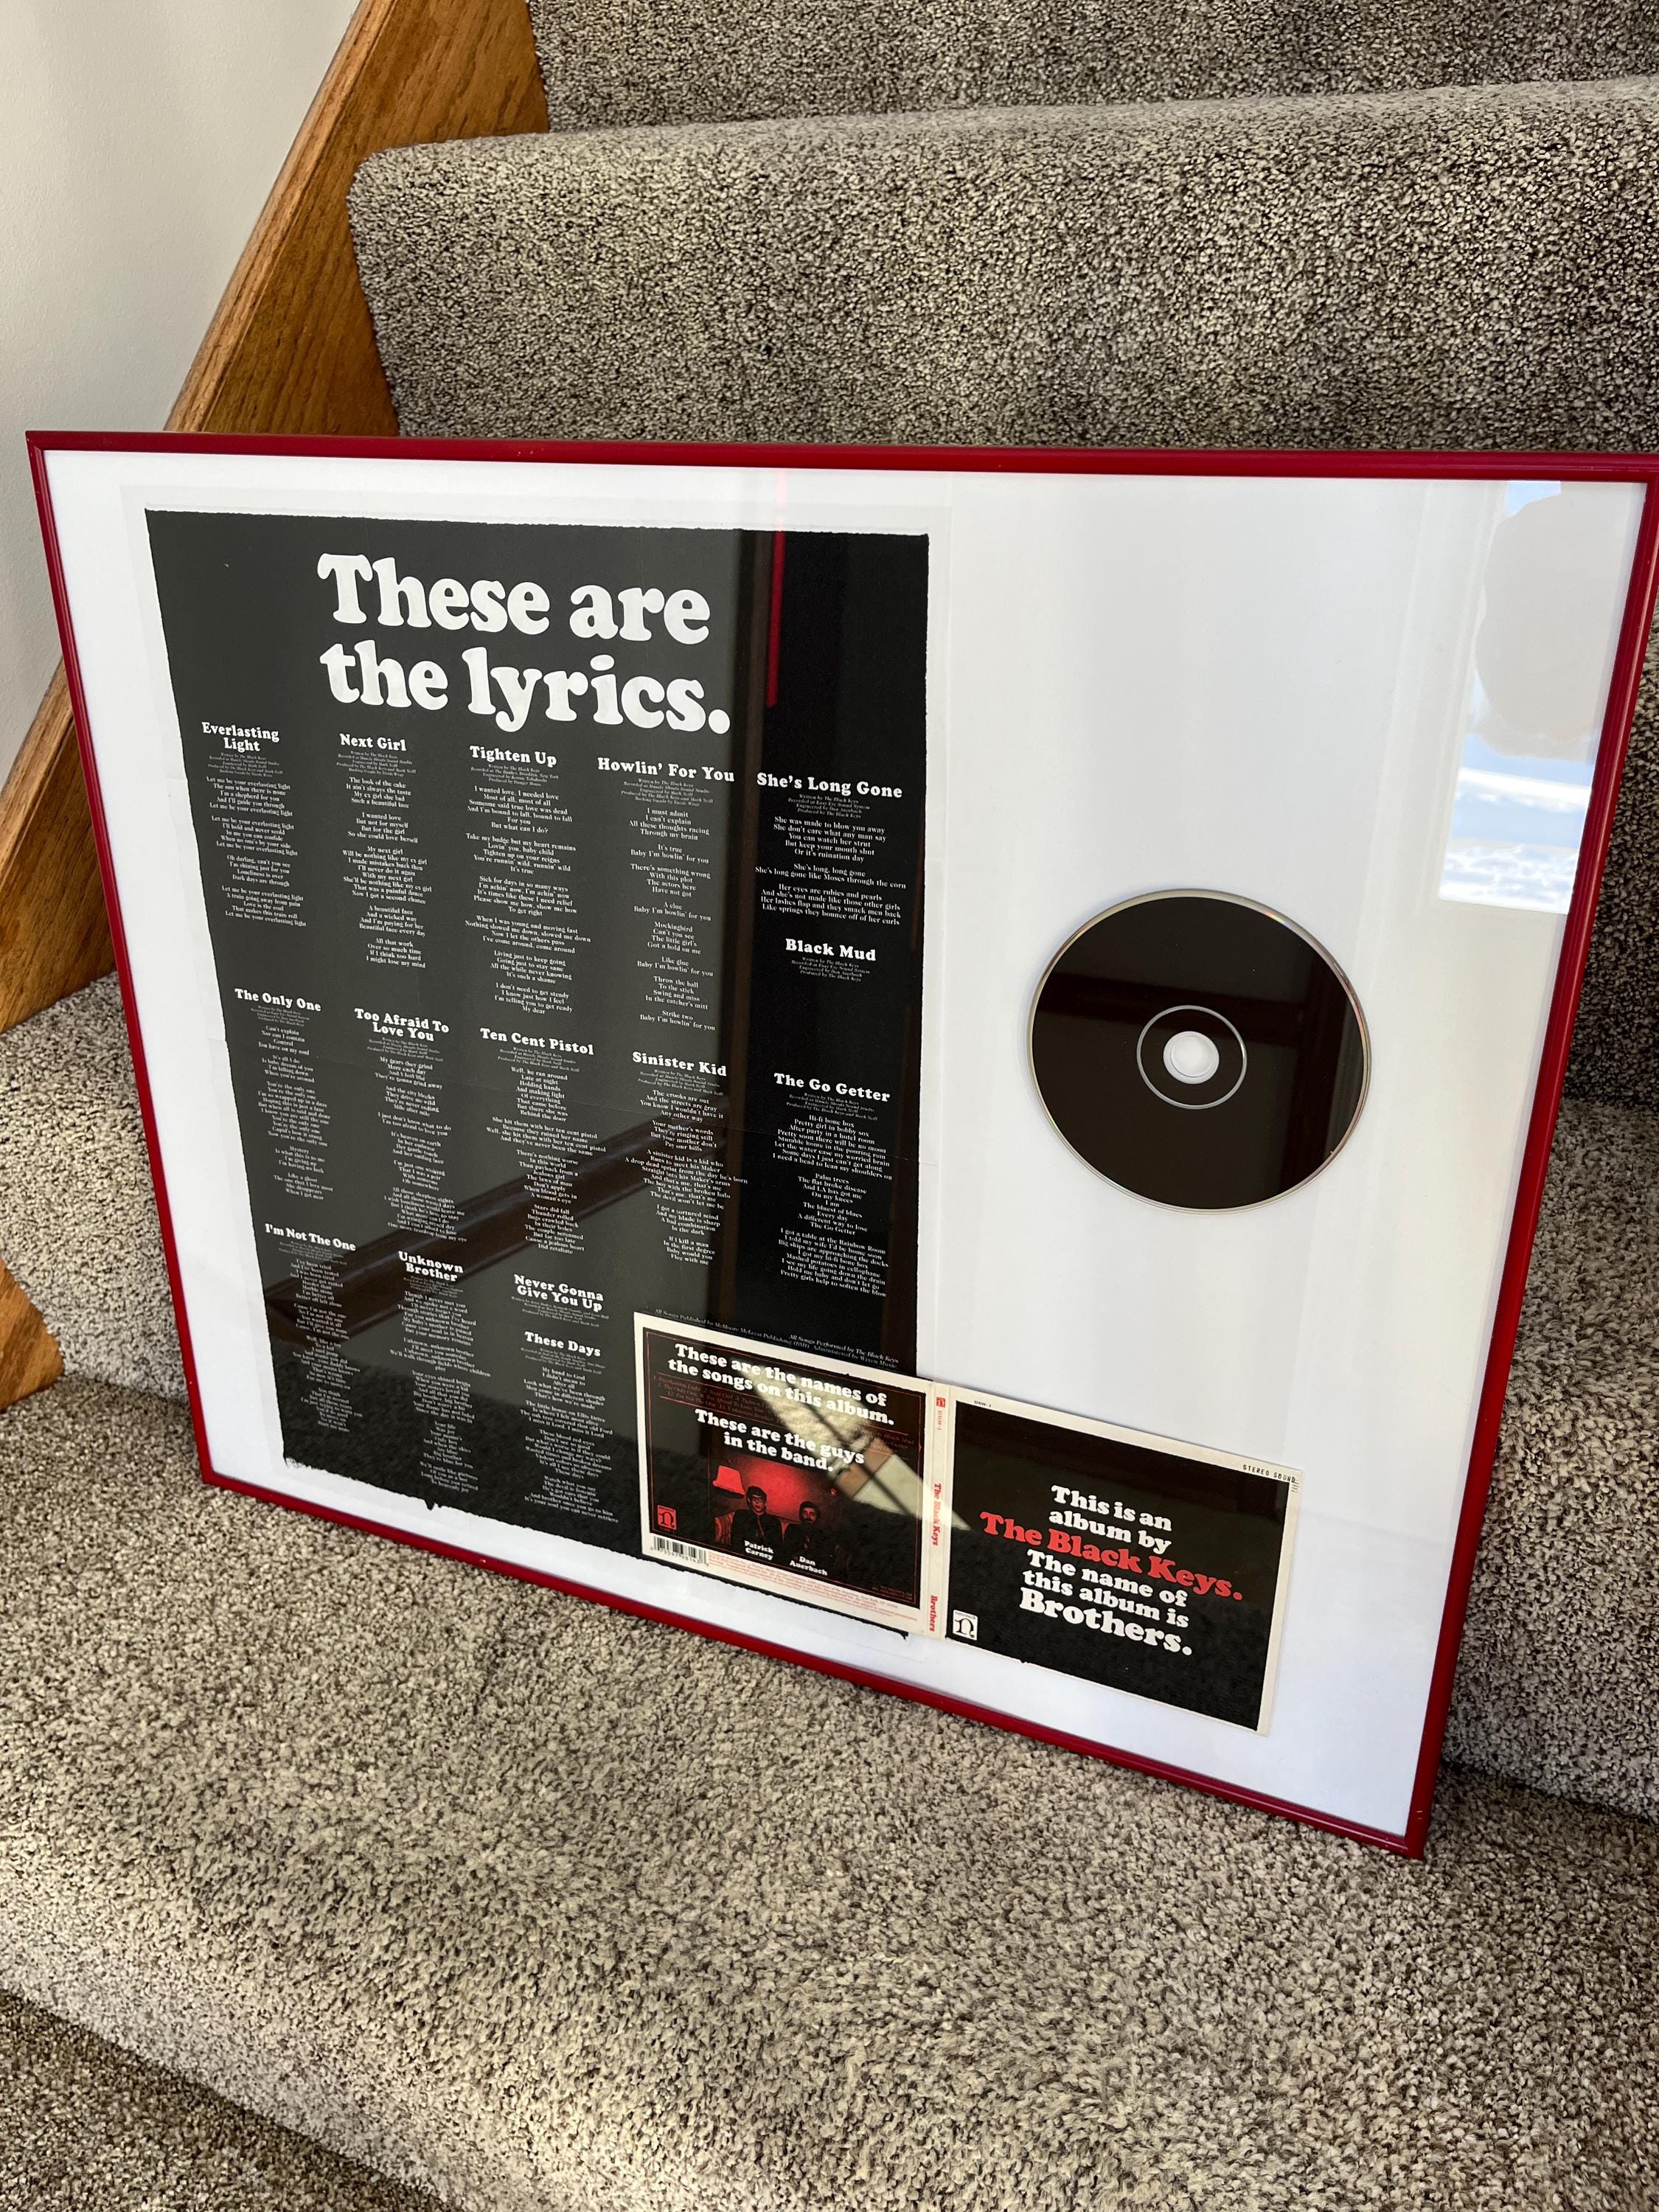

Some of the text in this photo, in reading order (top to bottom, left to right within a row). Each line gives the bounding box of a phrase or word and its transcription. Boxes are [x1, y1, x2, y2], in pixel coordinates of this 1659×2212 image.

[318, 554, 710, 644] These are
[320, 640, 730, 734] the lyrics.
[202, 721, 279, 742] Everlasting
[341, 733, 406, 751] Next Girl
[224, 737, 260, 752] Light
[469, 745, 556, 767] Tighten Up
[598, 757, 734, 781] Howlin' For You
[546, 792, 558, 800] love
[757, 772, 902, 797] She's Long Gone
[667, 817, 691, 825] explain
[669, 810, 688, 818] admit
[536, 826, 548, 834] do?
[867, 826, 885, 834] away
[799, 842, 815, 851] keep
[655, 922, 692, 933] Mockingbird
[785, 938, 875, 961] Black Mud
[234, 988, 321, 1011] The Only One
[354, 1008, 448, 1032] Too Afraid To
[373, 1021, 434, 1041] Love You
[480, 1027, 593, 1054] Ten Cent Pistol
[633, 1051, 726, 1076] Sinister Kid
[773, 1072, 890, 1101] The Go Getter
[815, 1172, 849, 1184] Palm trees
[817, 1211, 847, 1223] Every day
[265, 1223, 355, 1251] I'm Not The One
[398, 1251, 463, 1273] Unknown
[406, 1261, 457, 1281] Brother
[514, 1274, 603, 1301] Never Gonna
[517, 1285, 602, 1312] Give You Up
[524, 1331, 600, 1356] These Days
[675, 1343, 886, 1405] These are the names of
[669, 1359, 893, 1424] the songs on this album.
[695, 1409, 864, 1464] These are the guys
[724, 1432, 832, 1470] in the band.
[1242, 1464, 1295, 1483] STEREO SOUND
[1051, 1485, 1171, 1531] This is an
[931, 1525, 941, 1545] Keys
[1048, 1510, 1171, 1553] album by
[744, 1540, 773, 1551] Patrick
[745, 1548, 773, 1560] Carney
[980, 1512, 1242, 1599] The Black Keys.
[789, 1561, 827, 1576] Auerbach
[799, 1557, 815, 1566] Dan
[1027, 1548, 1187, 1607] The name of
[1023, 1570, 1189, 1627] this album is
[929, 1595, 938, 1632] Brothers
[1019, 1587, 1192, 1655] Brothers.
